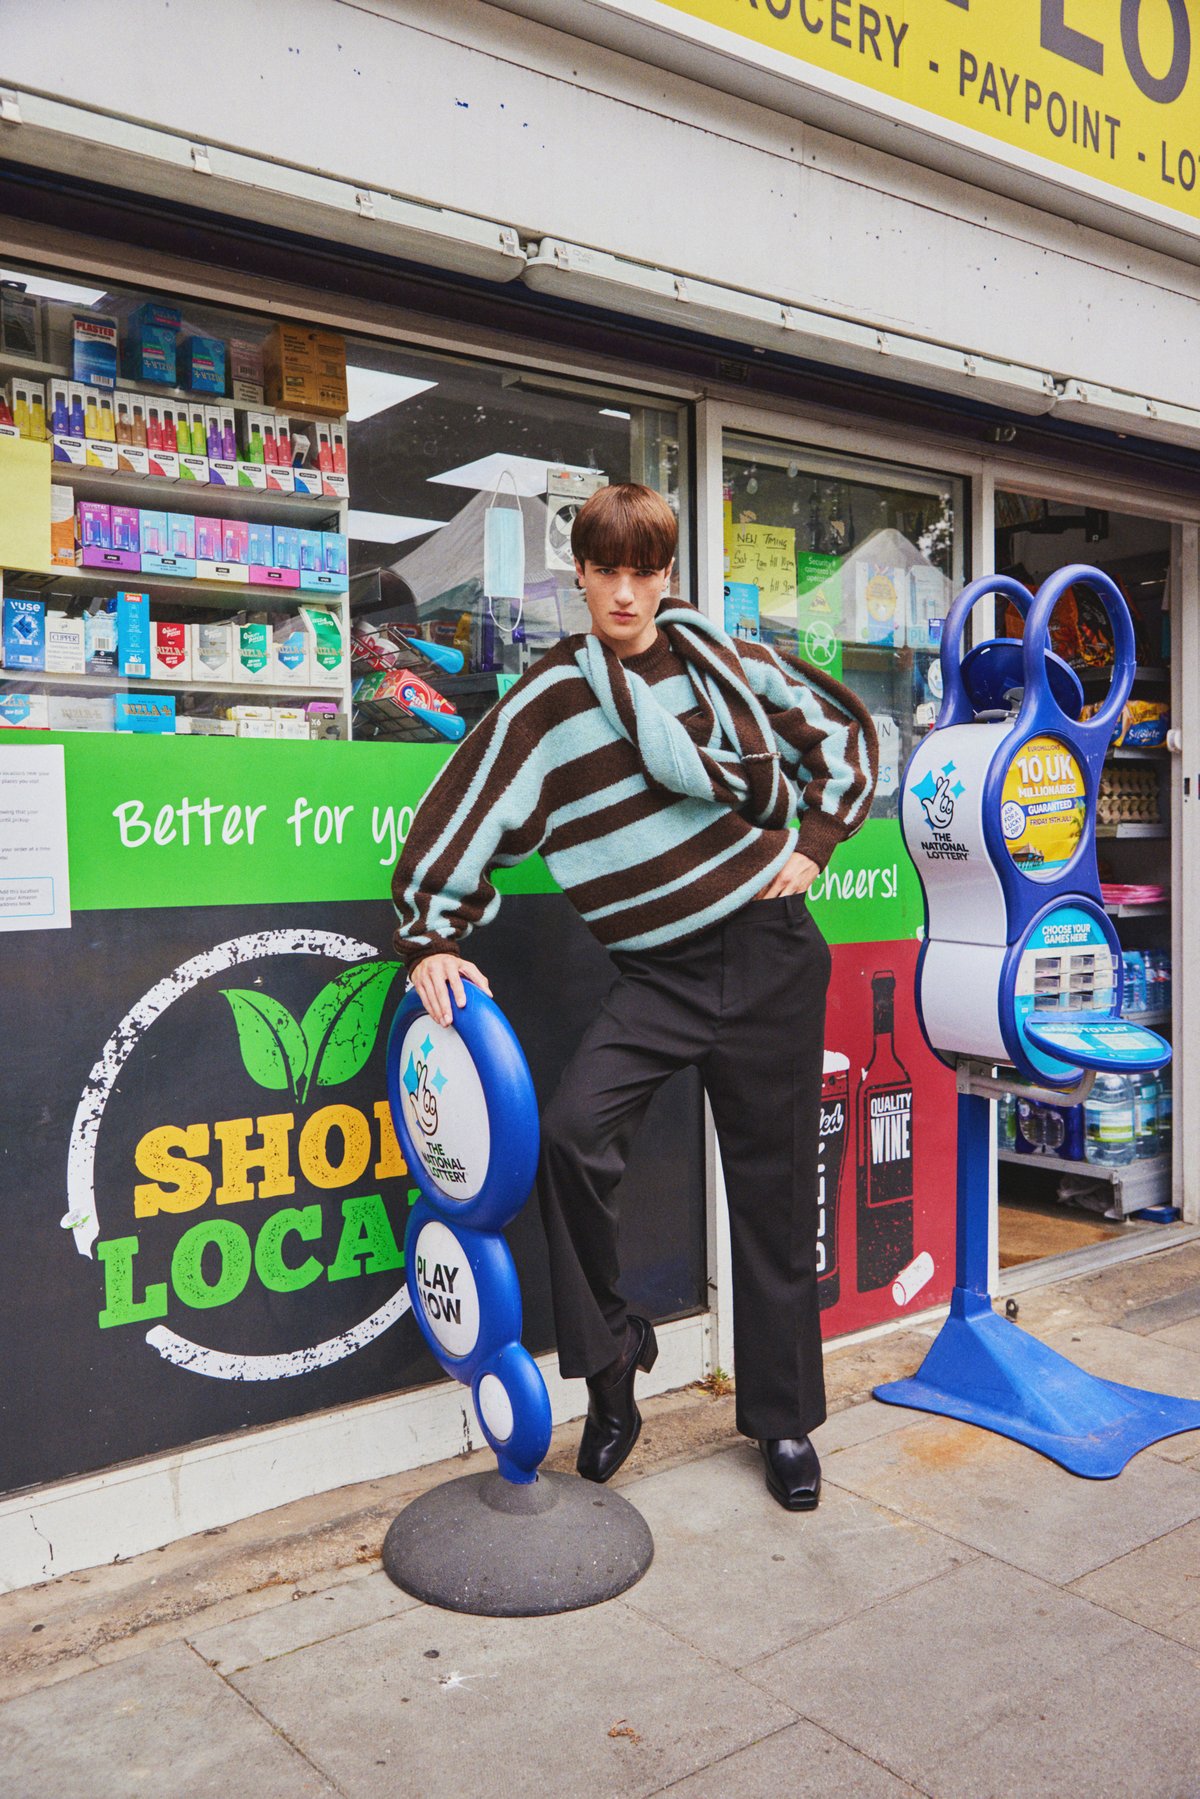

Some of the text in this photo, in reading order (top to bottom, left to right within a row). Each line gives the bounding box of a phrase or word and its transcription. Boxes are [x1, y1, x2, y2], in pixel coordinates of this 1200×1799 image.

[959, 48, 1121, 160] PAYPOINT
[1161, 139, 1200, 192] LO
[76, 321, 115, 337] PLASTER
[737, 532, 758, 545] NEW
[1016, 753, 1076, 785] 10 UK
[1018, 783, 1076, 798] MILLIONAIRES
[1004, 806, 1014, 816] ASK
[1028, 799, 1073, 815] GUARANTEED
[1004, 816, 1022, 831] LUCKY
[1029, 818, 1048, 826] FRIDAY
[112, 796, 415, 866] Better for yo
[932, 832, 952, 842] THE
[921, 841, 969, 853] NATIONAL
[926, 851, 969, 861] LOTTERY
[1042, 923, 1091, 936] CHOOSE YOUR
[1044, 932, 1089, 945] GAMES HERE
[870, 1092, 912, 1117] QUALITY
[870, 1112, 911, 1165] WINE
[426, 1141, 446, 1156] THE
[421, 1151, 466, 1170] NATIONAL
[428, 1165, 467, 1184] LOTTERY
[97, 1189, 422, 1330] LOCA
[417, 1255, 459, 1294] PLAY
[418, 1285, 462, 1325] NOW
